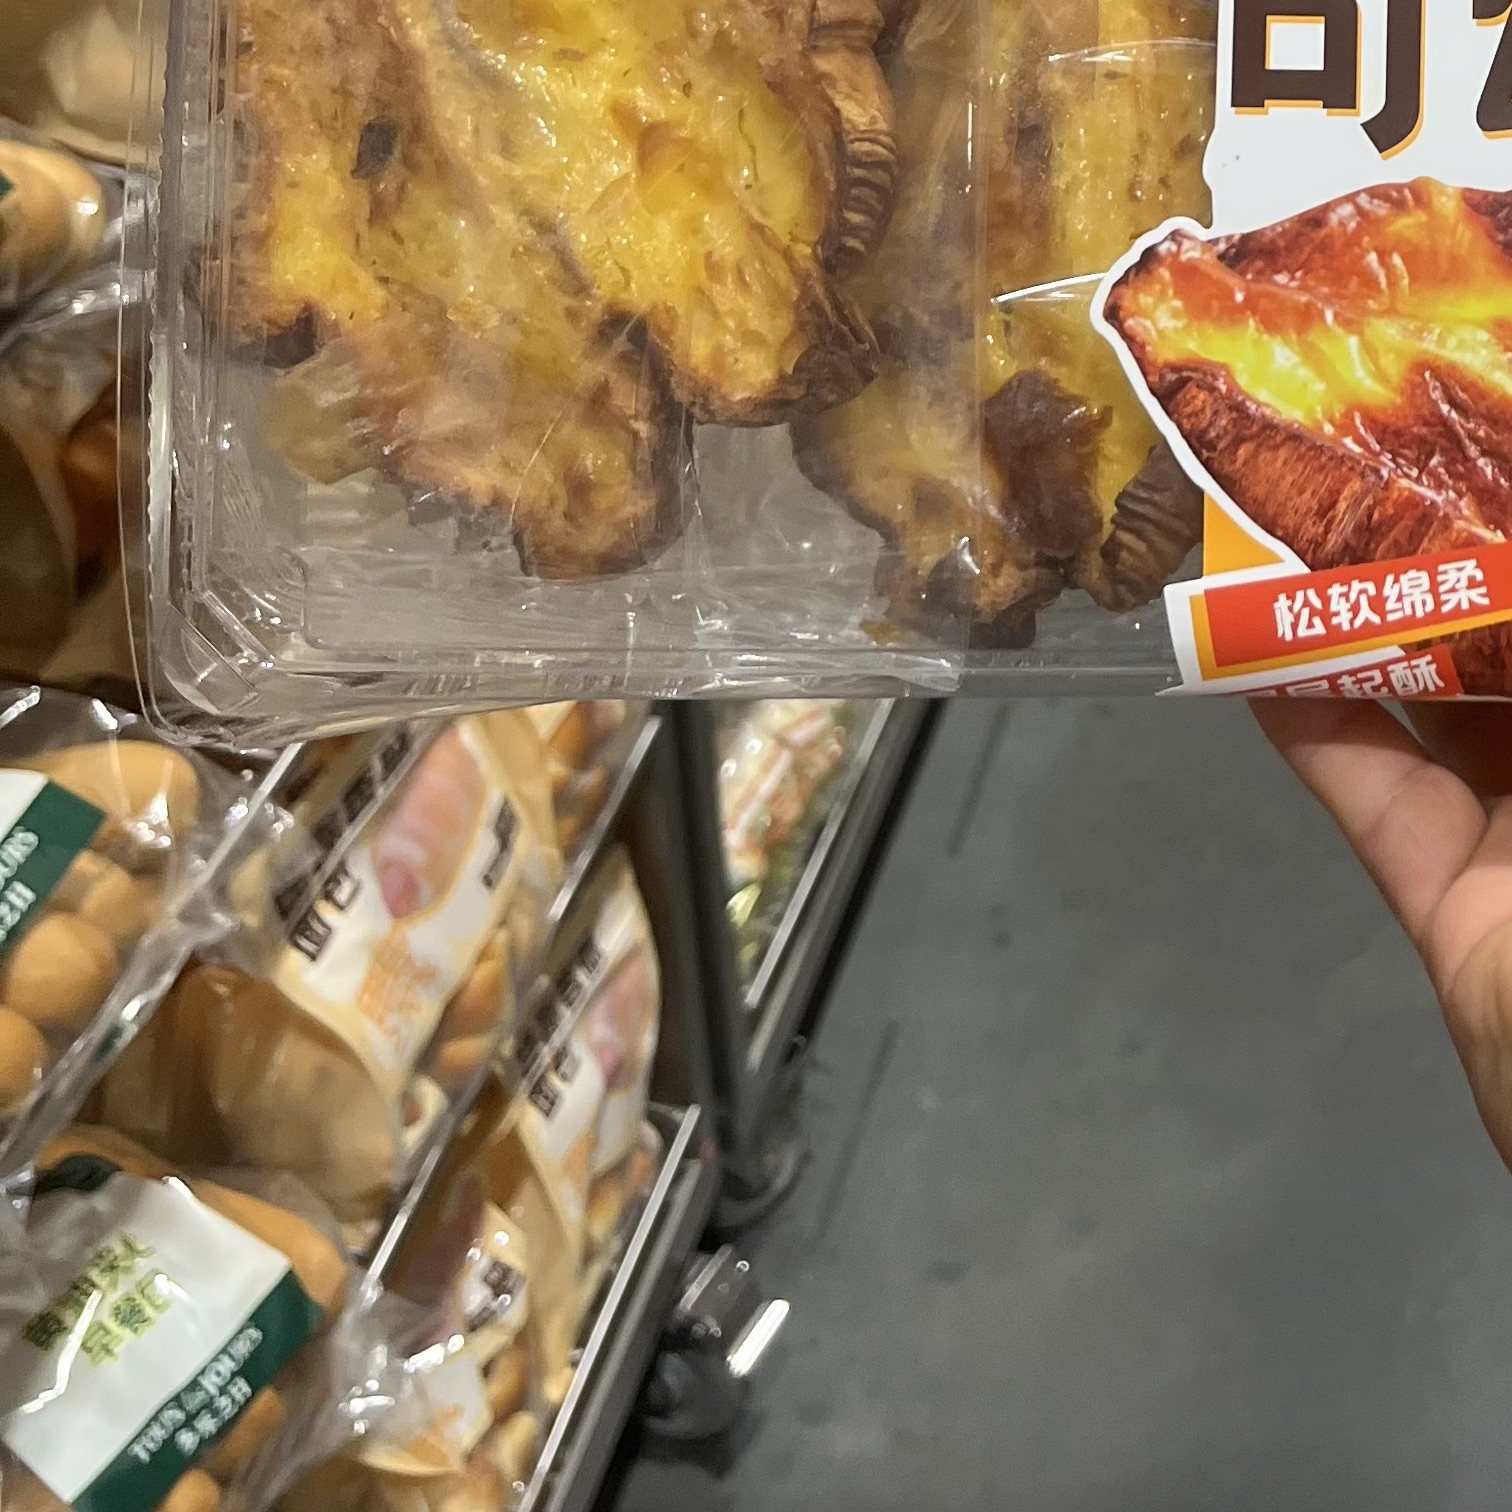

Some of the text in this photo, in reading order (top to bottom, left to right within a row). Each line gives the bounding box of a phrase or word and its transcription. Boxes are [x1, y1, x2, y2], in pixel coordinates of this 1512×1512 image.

[1273, 558, 1491, 642] 松软绵柔
[1254, 654, 1446, 697] 起酥
